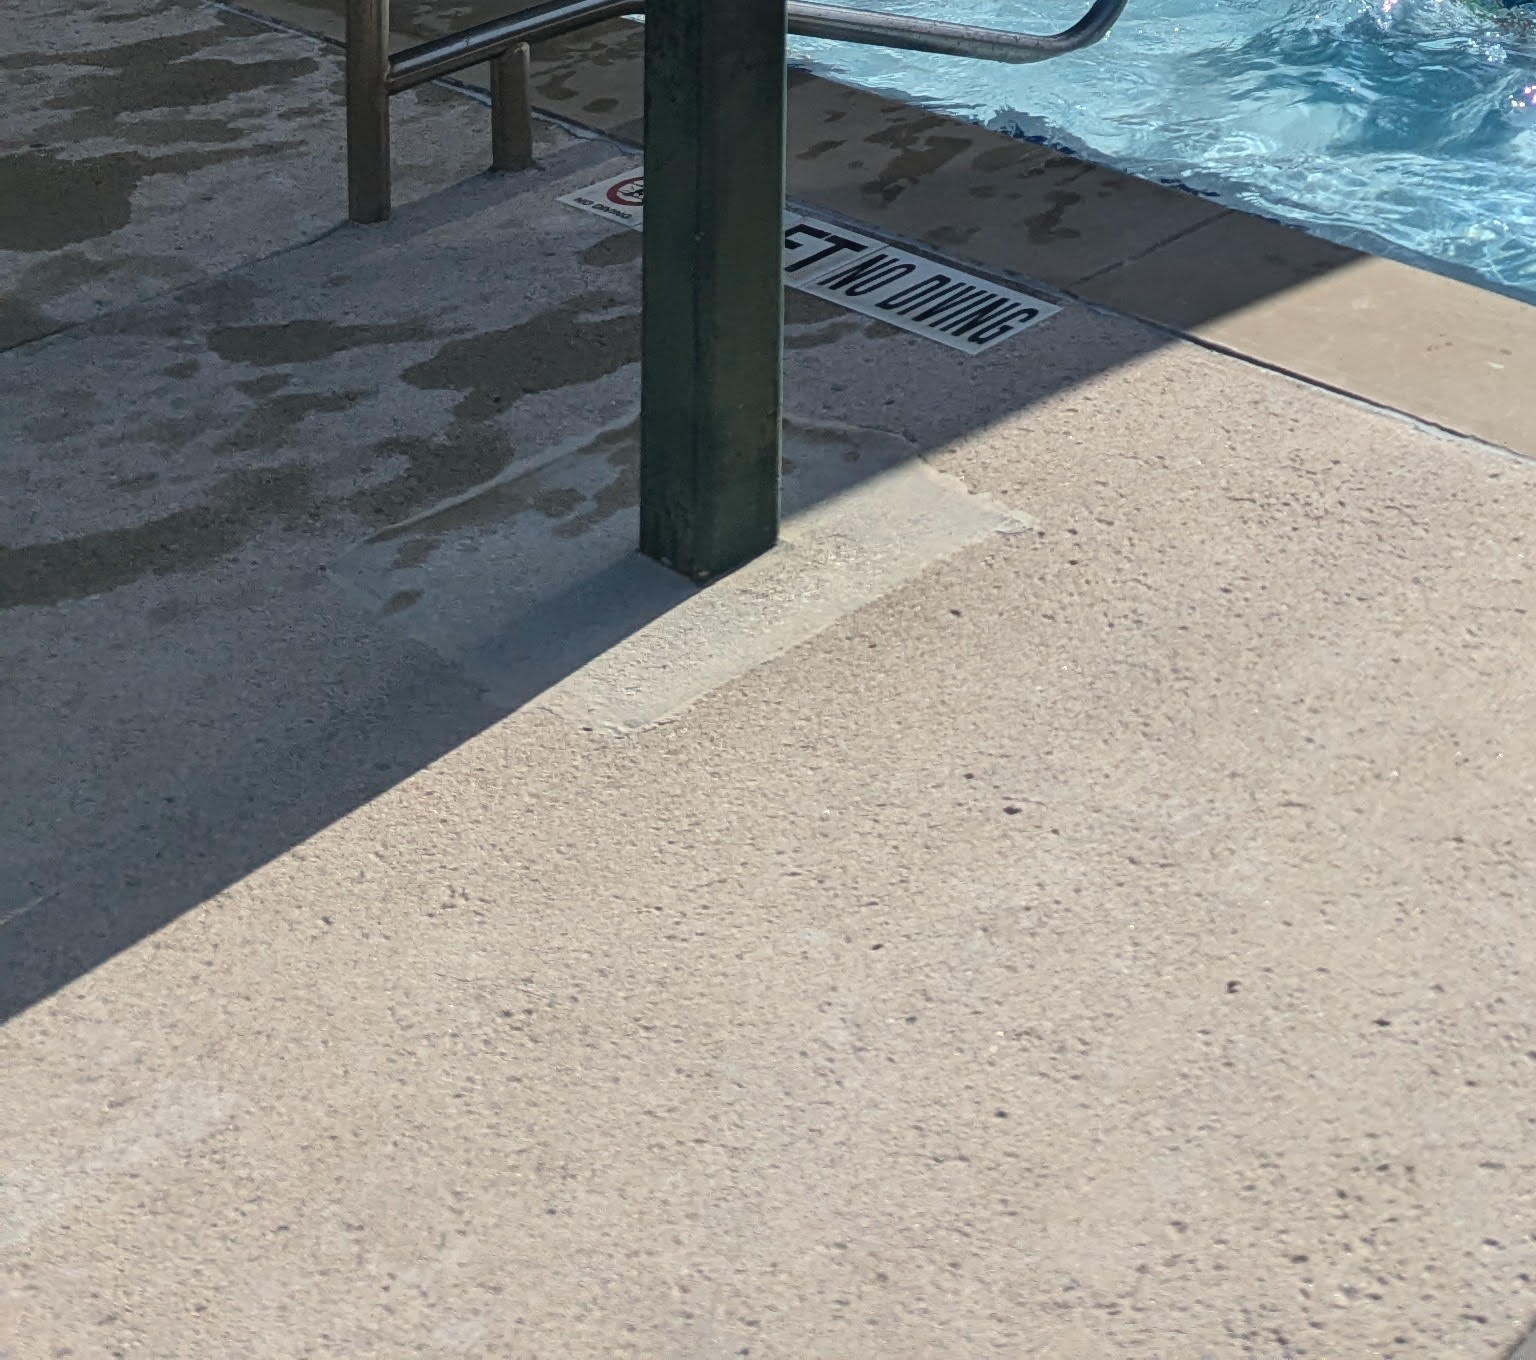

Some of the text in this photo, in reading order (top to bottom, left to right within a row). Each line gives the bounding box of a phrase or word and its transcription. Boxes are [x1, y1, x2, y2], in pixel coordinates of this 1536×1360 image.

[574, 196, 633, 220] NO DIVING
[816, 253, 917, 297] NO
[874, 273, 1039, 345] DIVING
